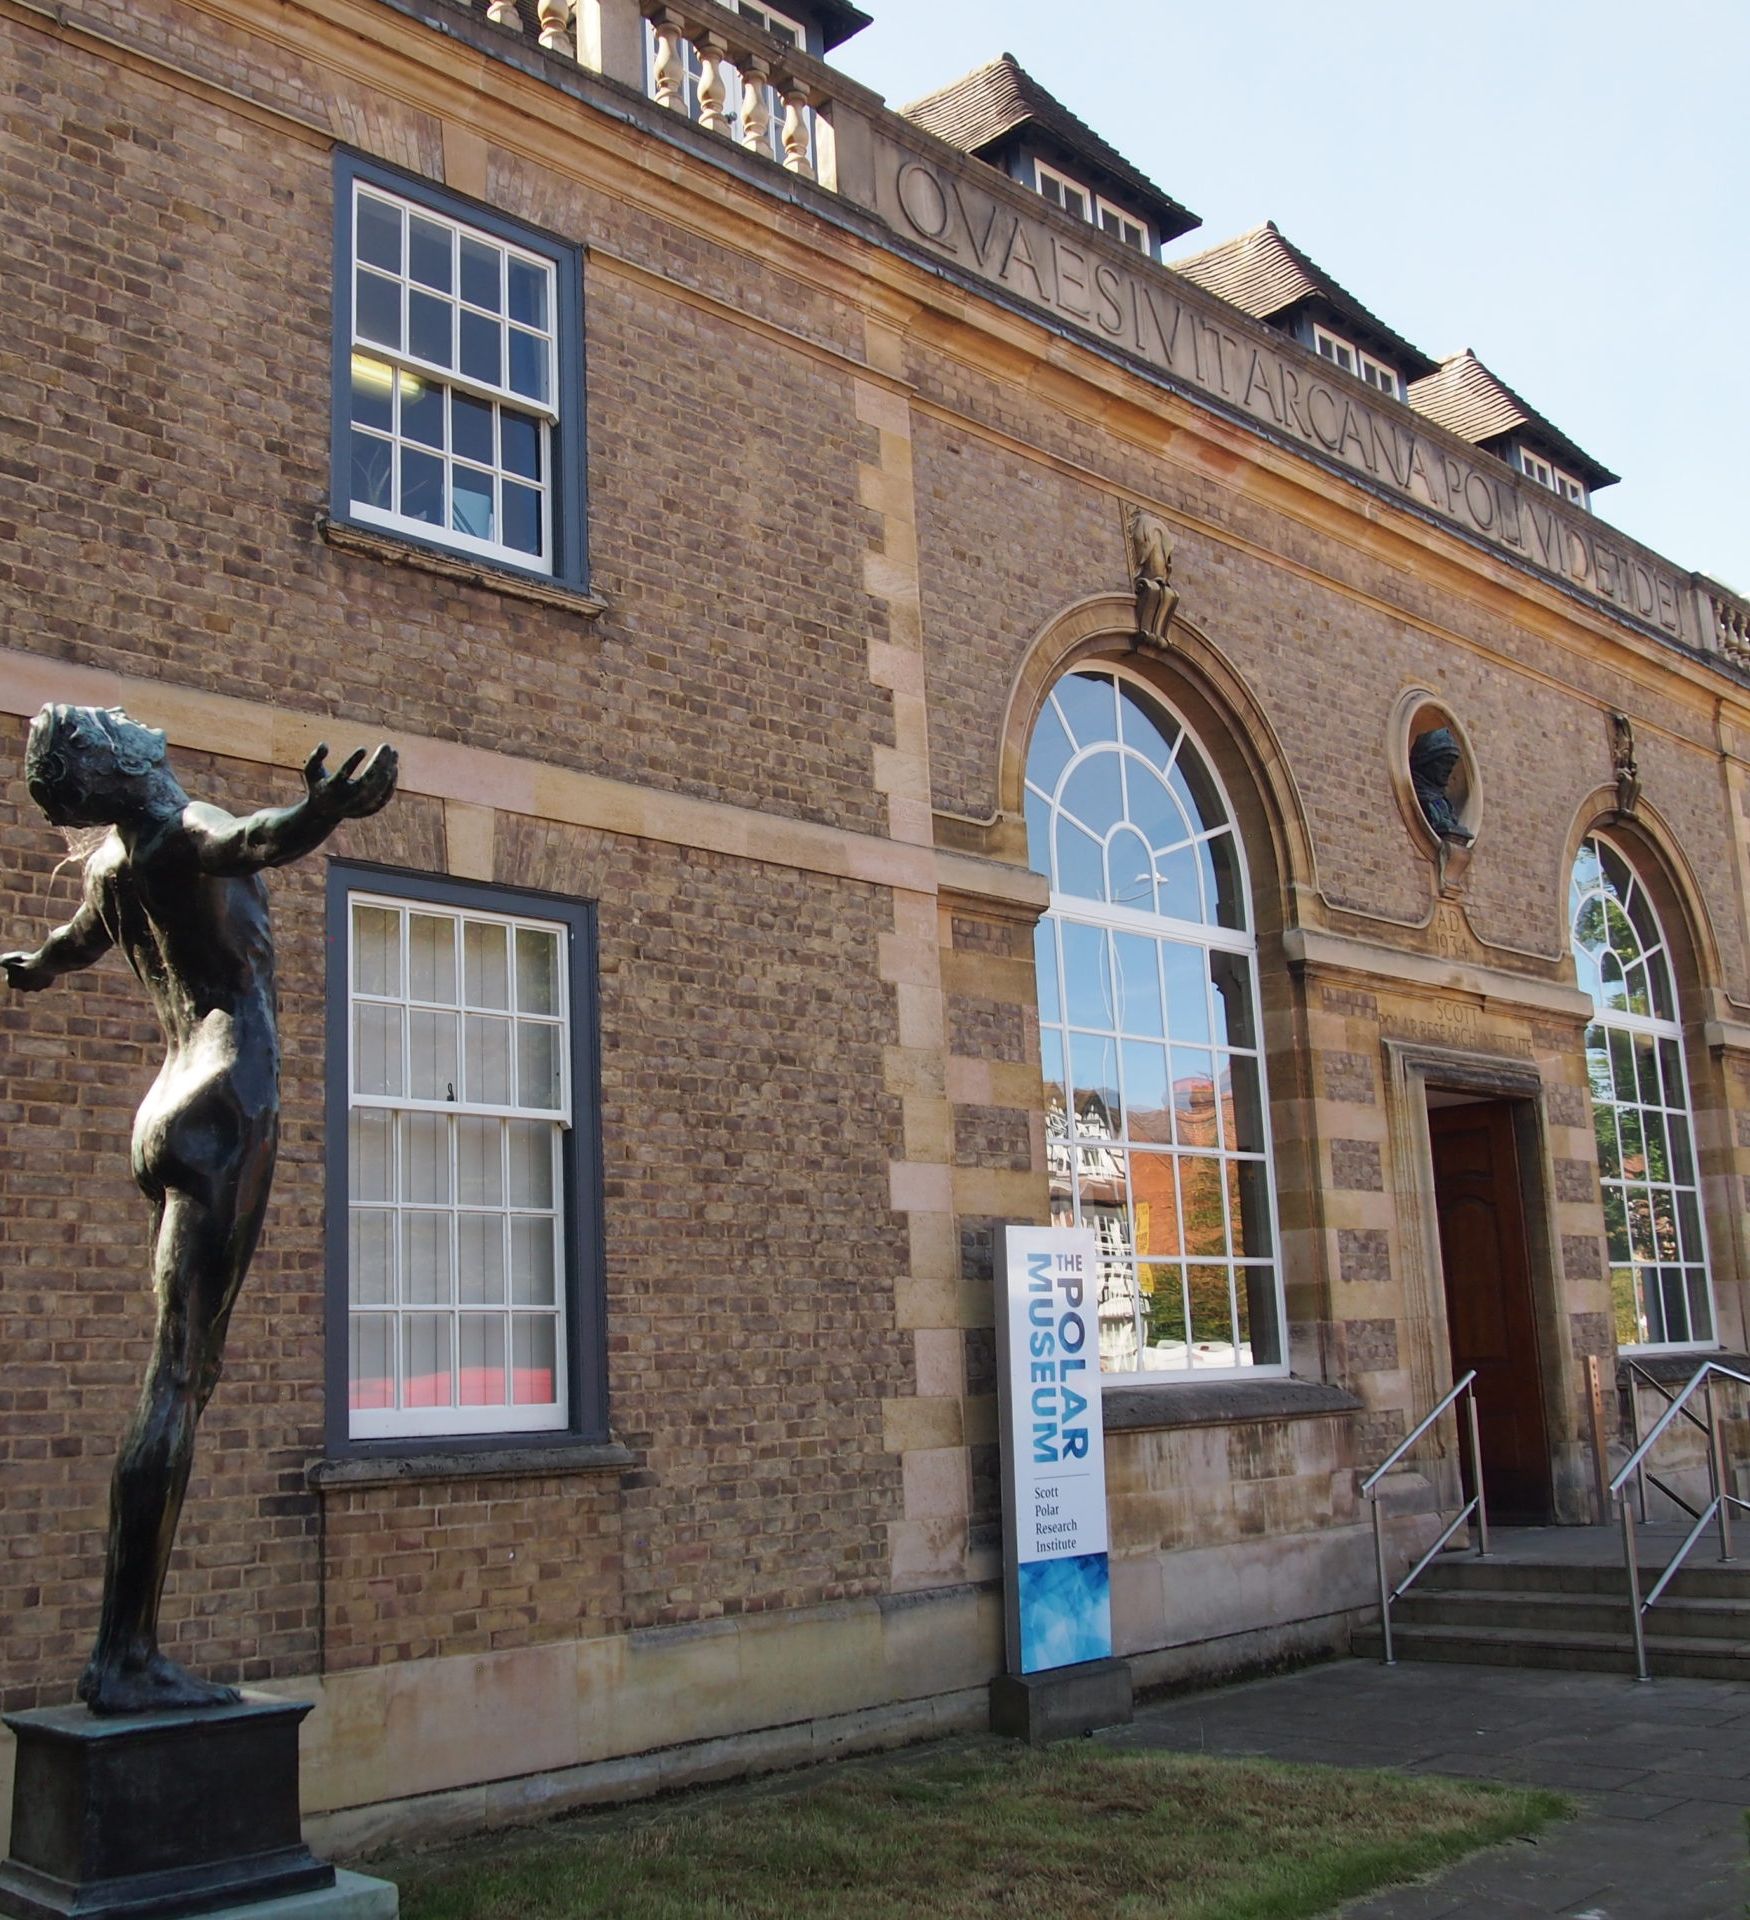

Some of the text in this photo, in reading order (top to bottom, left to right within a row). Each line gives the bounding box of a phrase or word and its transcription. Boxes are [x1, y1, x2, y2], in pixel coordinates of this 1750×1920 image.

[1243, 348, 1438, 504] ARCANA
[1436, 930, 1469, 956] 1934
[1436, 1000, 1478, 1025] SCOTT
[1418, 1020, 1475, 1047] RESEARCH
[1056, 1254, 1083, 1272] THE
[1027, 1252, 1059, 1463] MUSEUM
[1057, 1278, 1089, 1460] POLAR
[1034, 1487, 1058, 1500] Scott
[1035, 1503, 1059, 1517] Polar
[1036, 1518, 1078, 1536] Research
[1036, 1537, 1077, 1553] Institute
